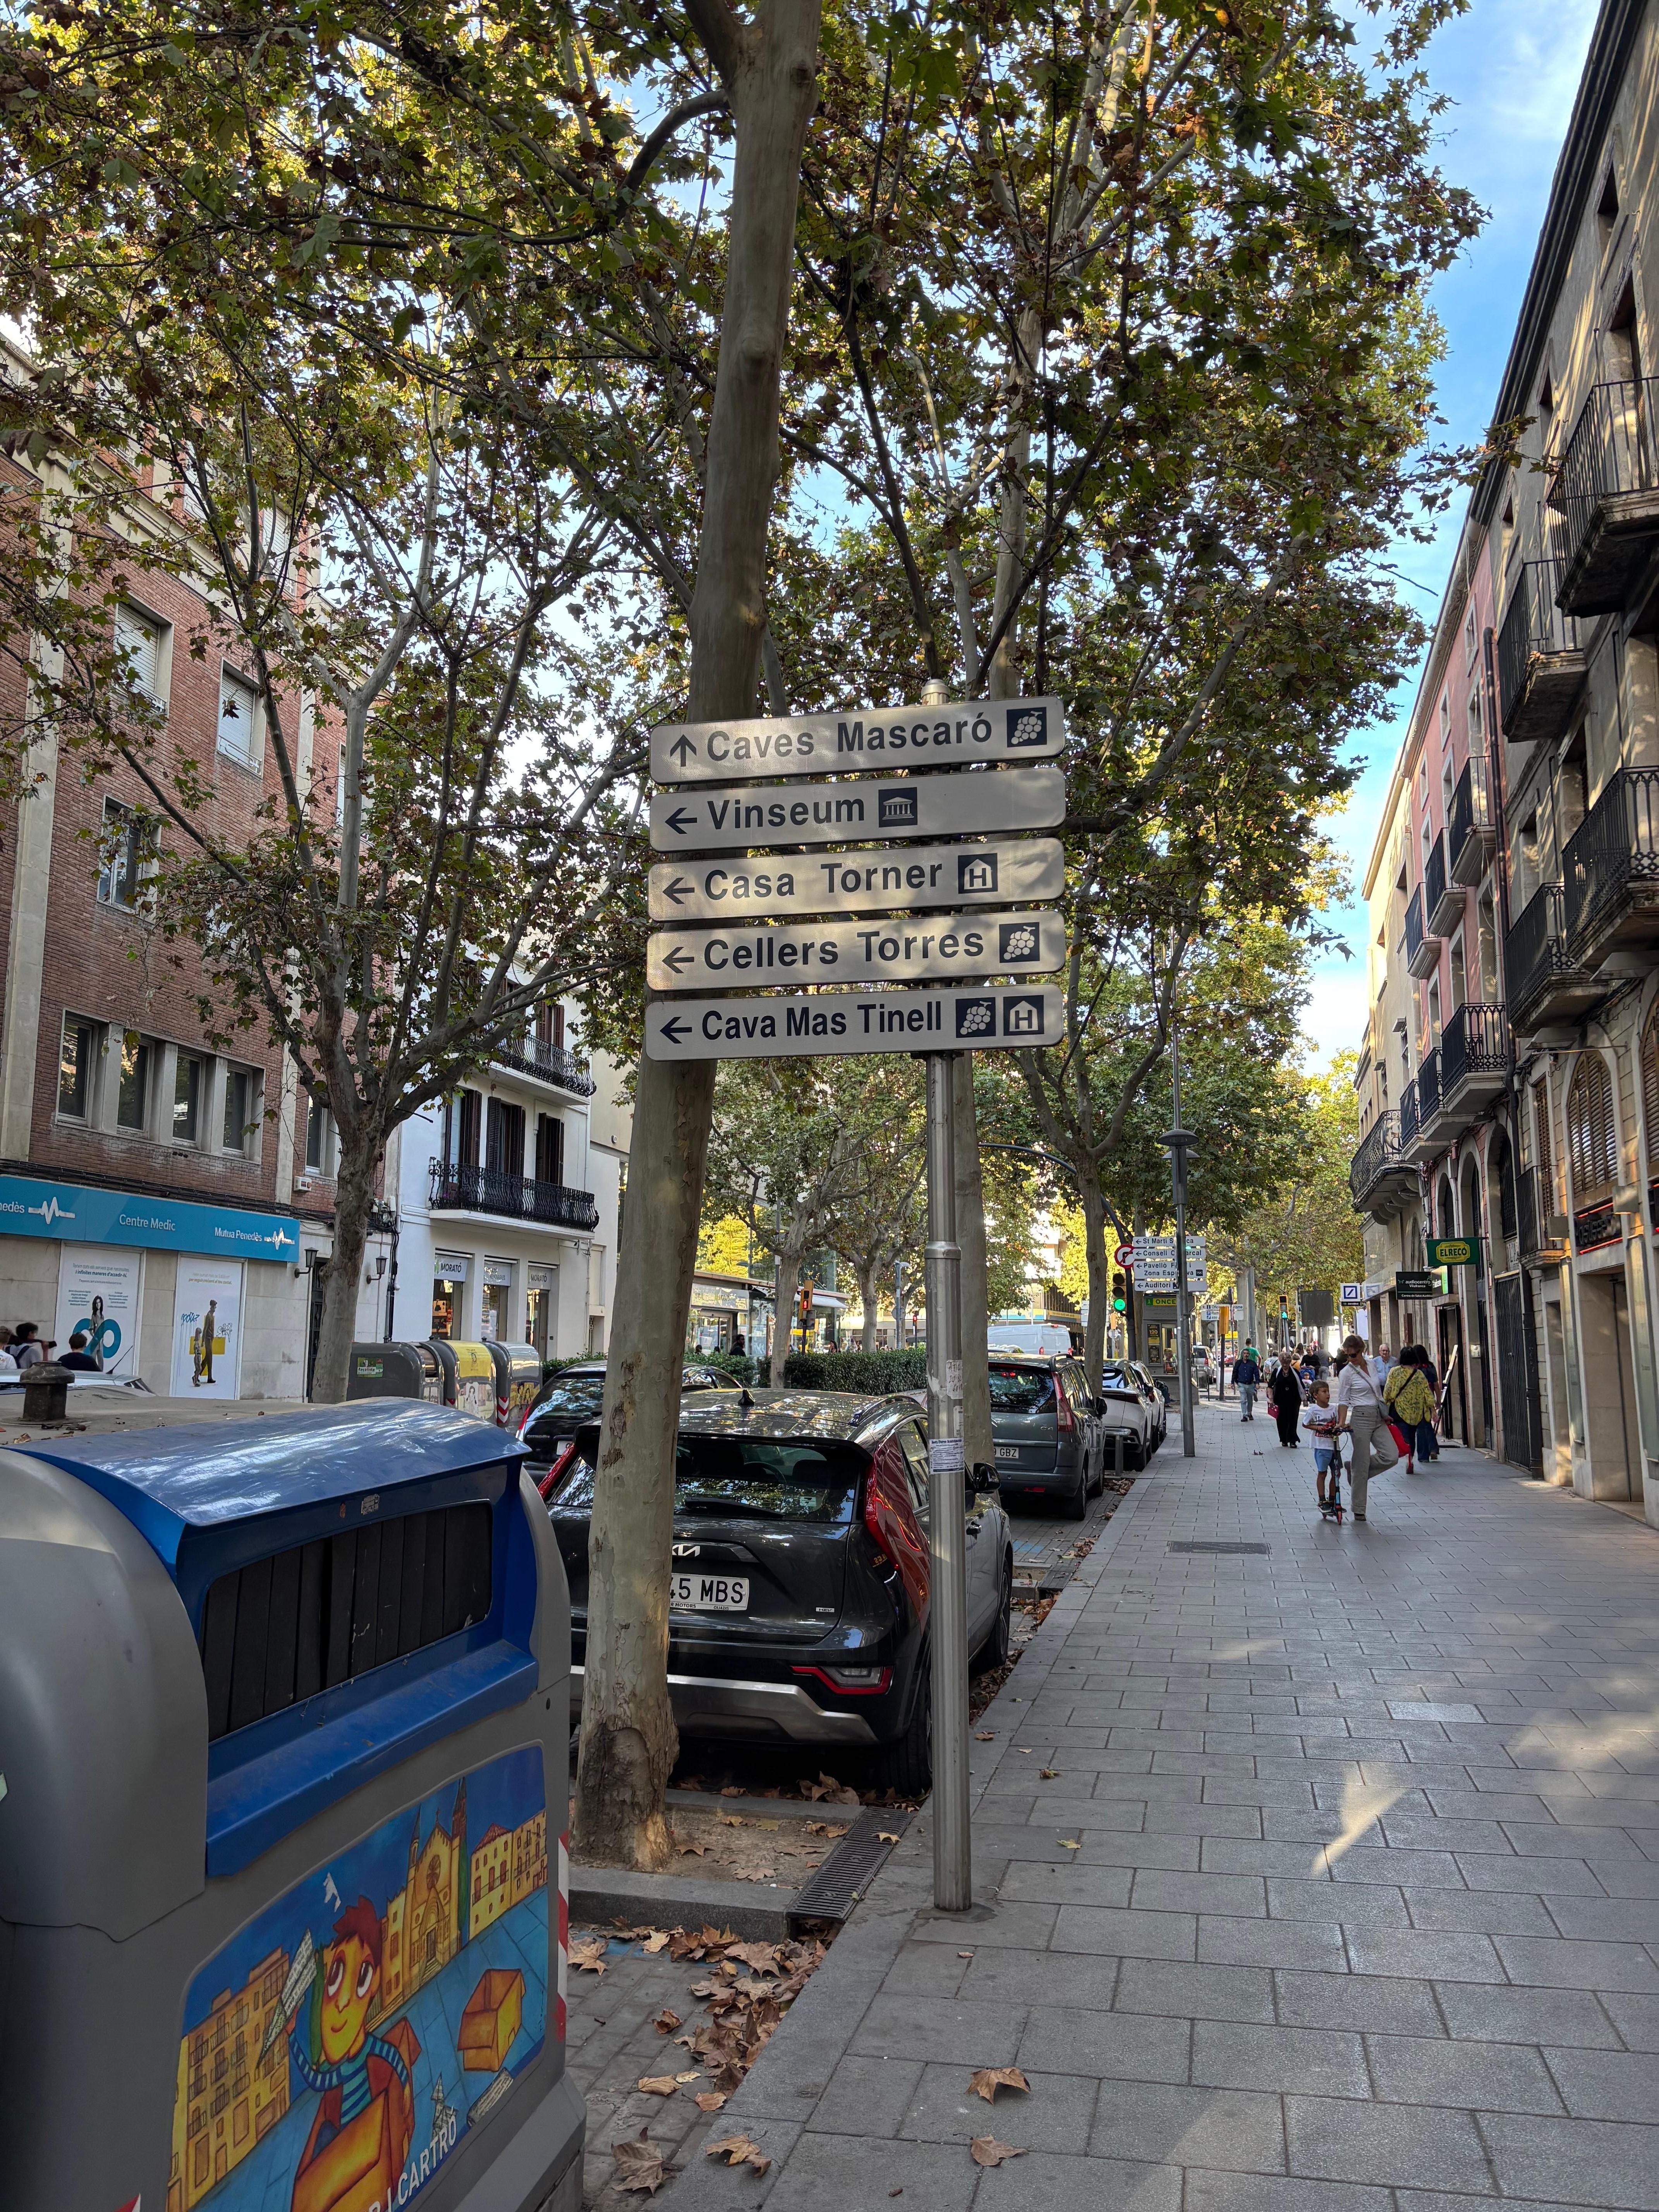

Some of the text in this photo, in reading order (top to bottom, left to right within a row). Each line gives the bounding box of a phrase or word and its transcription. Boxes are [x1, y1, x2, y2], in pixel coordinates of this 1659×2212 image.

[708, 712, 993, 762] Caves Mascaró
[708, 798, 865, 830] Vinseum
[704, 870, 795, 900] Casa
[821, 862, 942, 894] Torner
[703, 931, 984, 970] Cellers Torres
[702, 1010, 776, 1041] Cava
[786, 1006, 847, 1037] Mas
[857, 1000, 942, 1034] Tinell
[119, 1214, 176, 1231] Centre Medic
[215, 1227, 262, 1242] Mutua Penedès
[440, 1262, 462, 1273] MORATÓ
[531, 1273, 547, 1282] MORATÓ
[1000, 1448, 1017, 1457] GBZ
[700, 1579, 744, 1604] MBS
[398, 2105, 457, 2205] CARTRÓ
